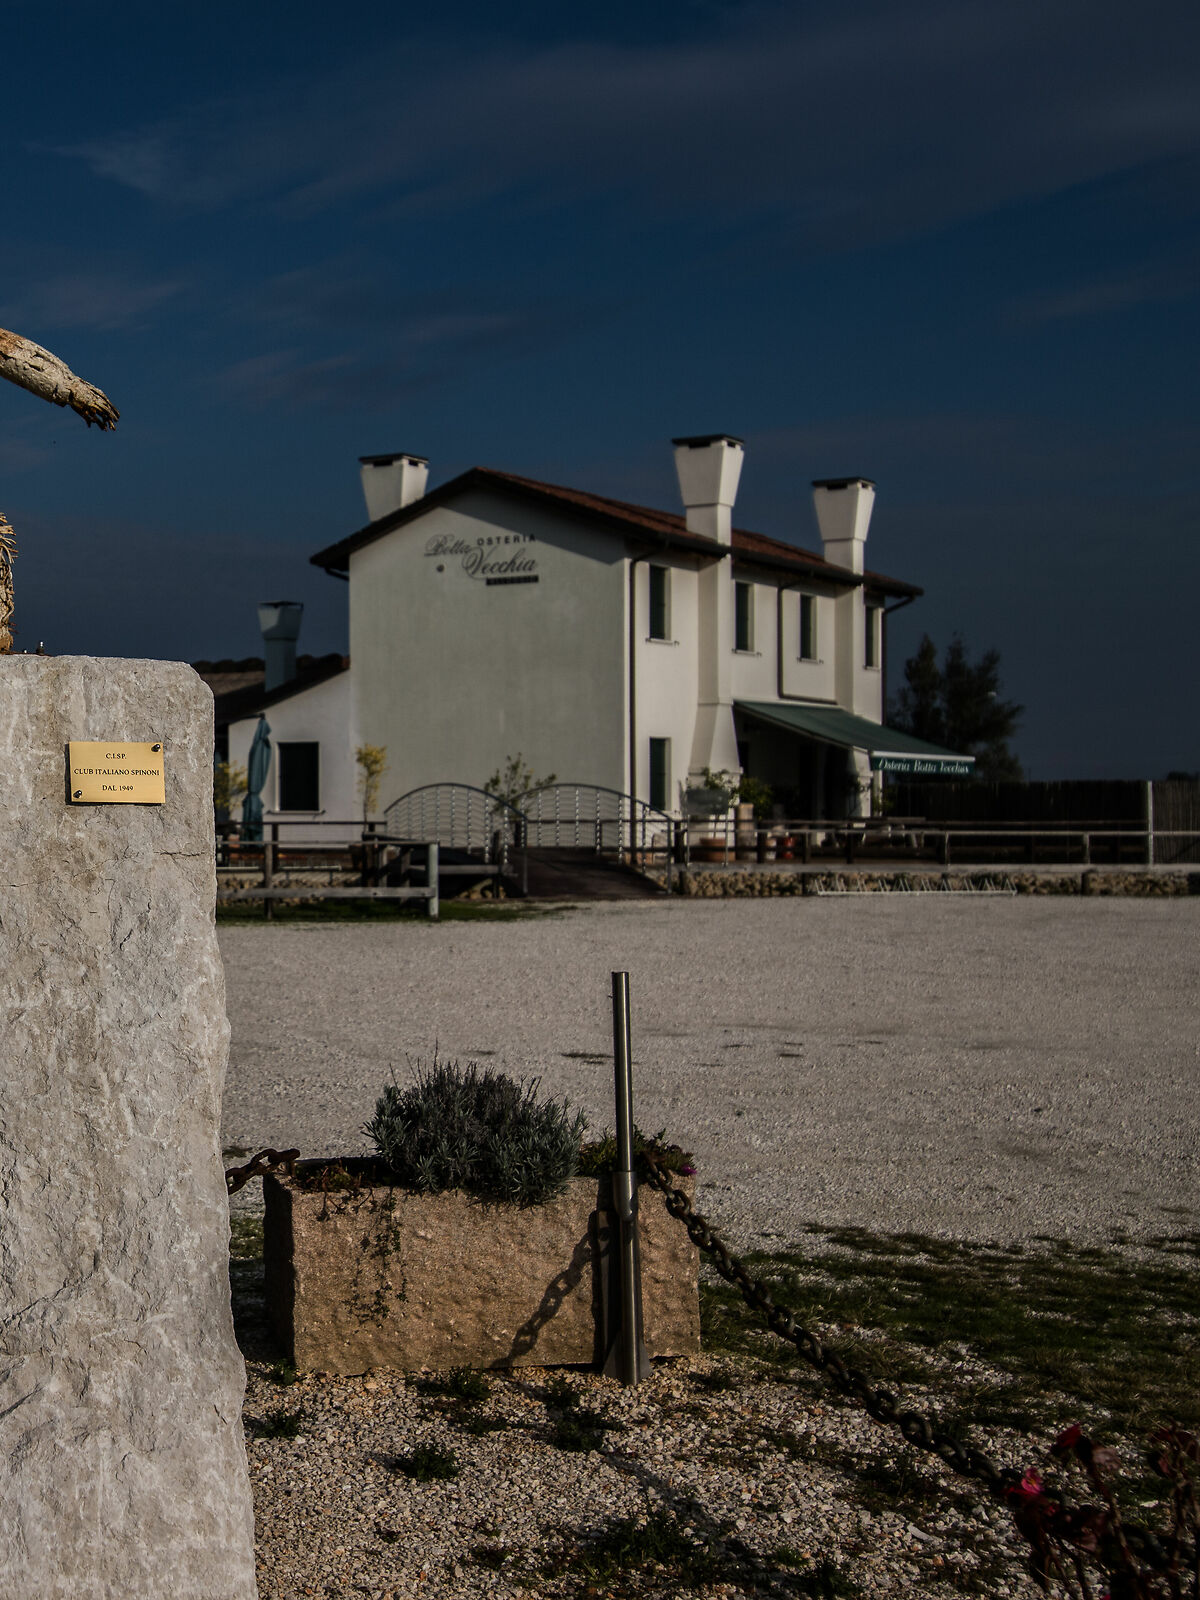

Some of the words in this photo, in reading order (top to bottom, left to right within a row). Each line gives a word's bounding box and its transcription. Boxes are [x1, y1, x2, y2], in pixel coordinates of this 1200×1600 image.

[477, 534, 536, 545] OSTERIA
[461, 545, 537, 580] Vecchia
[95, 768, 130, 776] ITALIANO
[103, 784, 118, 792] DAL
